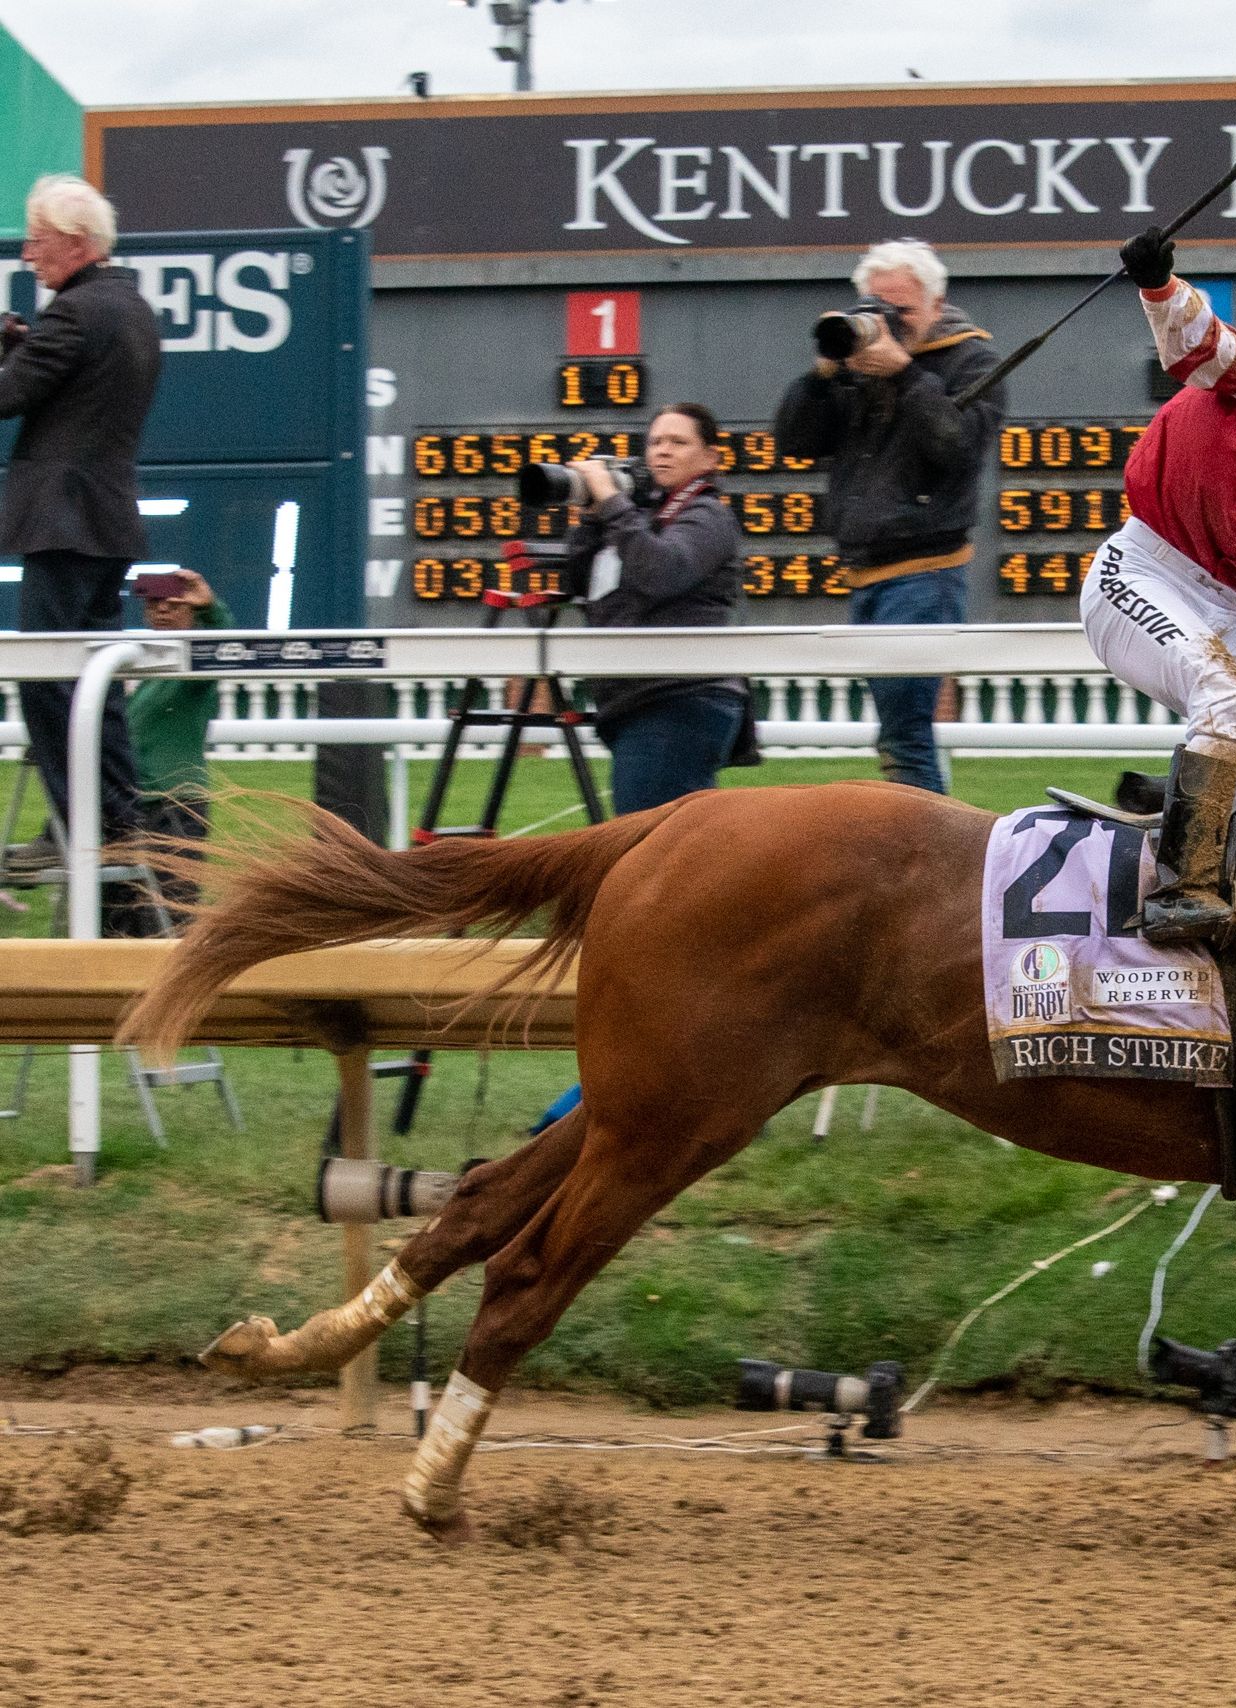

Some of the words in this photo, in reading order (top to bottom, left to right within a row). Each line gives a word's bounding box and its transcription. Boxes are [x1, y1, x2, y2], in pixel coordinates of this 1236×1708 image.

[563, 136, 1172, 244] KENTUCKY
[591, 300, 617, 349] 1
[1003, 810, 1147, 939] 21
[1012, 982, 1057, 993] KENTUCKY
[1096, 970, 1209, 985] WOODFORD
[1012, 989, 1067, 1021] DERBY
[1108, 988, 1199, 1002] RESERVE
[1011, 1035, 1097, 1067] RICH
[1108, 1036, 1229, 1072] STRIKE
